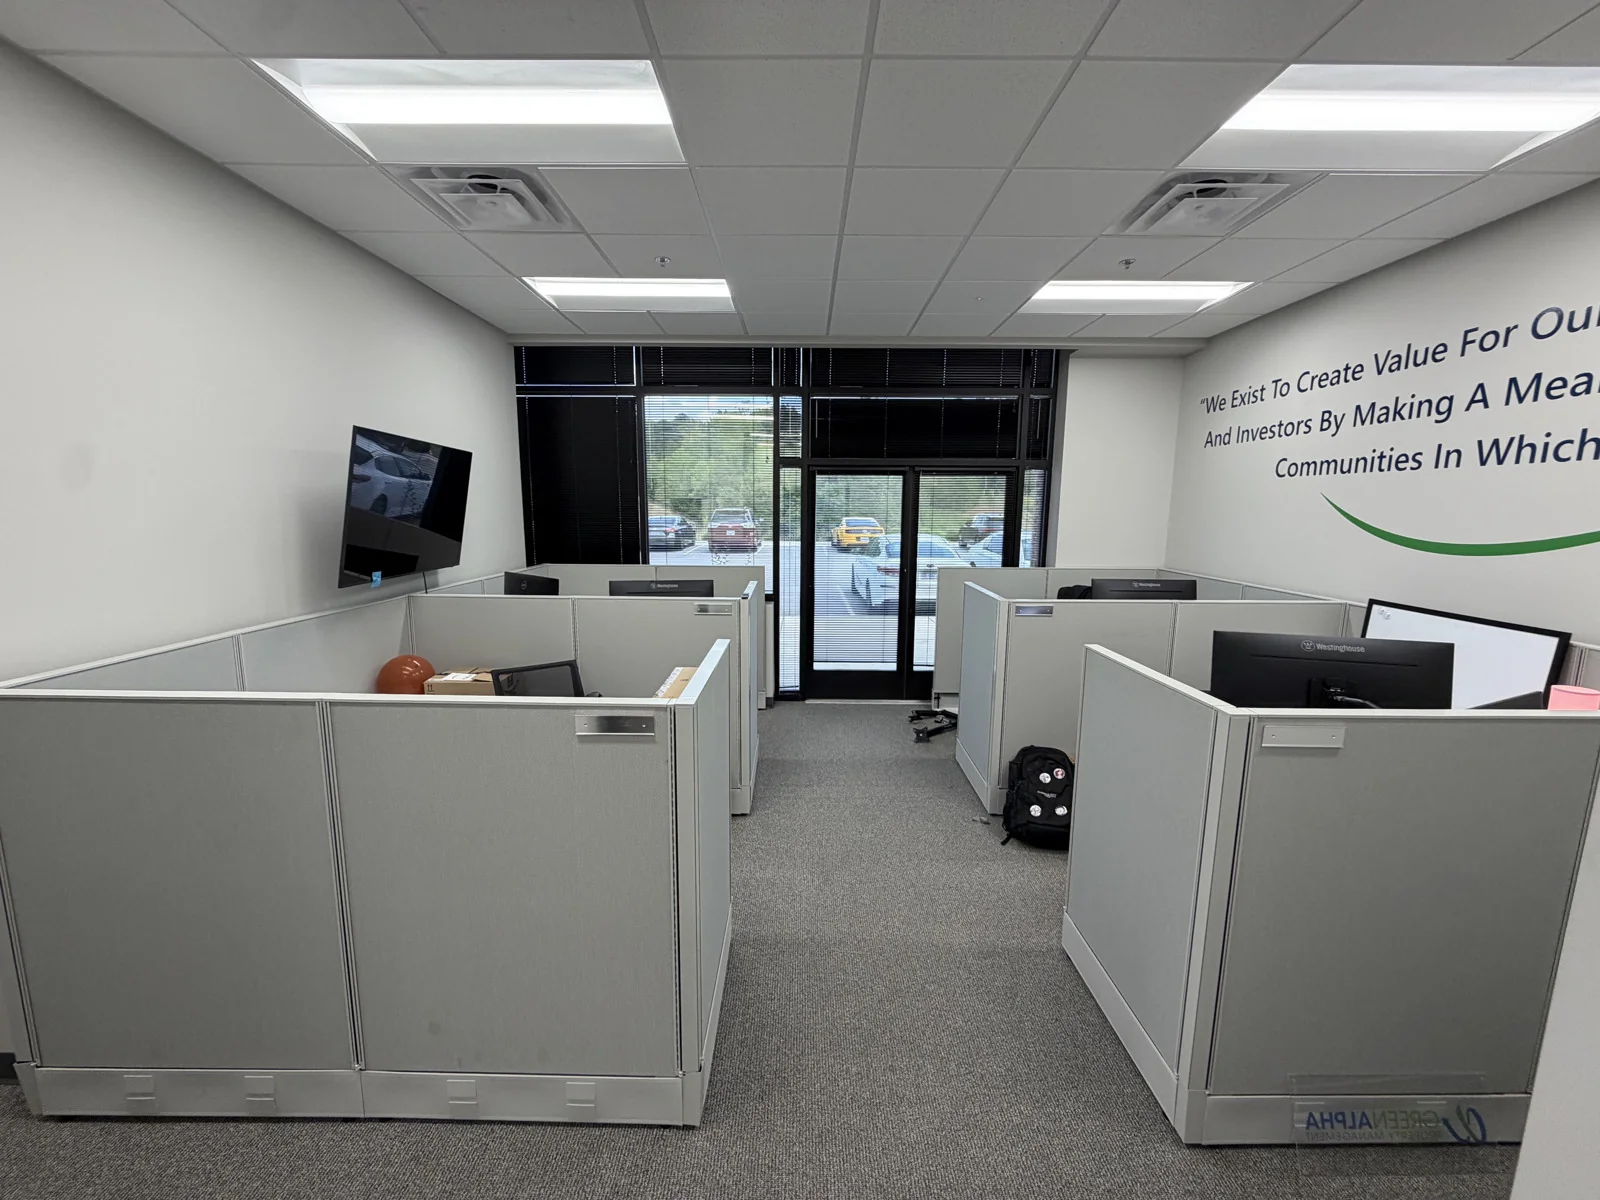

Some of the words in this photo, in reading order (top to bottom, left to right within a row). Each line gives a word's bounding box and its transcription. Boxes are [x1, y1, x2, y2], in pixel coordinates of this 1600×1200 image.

[1231, 385, 1266, 409] Exist
[1271, 378, 1290, 400] To
[1297, 362, 1364, 394] Create
[1373, 342, 1448, 376] Value
[1460, 324, 1518, 358] For
[1204, 426, 1232, 449] And
[1235, 416, 1313, 444] Investors
[1319, 409, 1346, 438] By
[1353, 393, 1454, 428] Making
[1464, 382, 1490, 413] A
[1503, 371, 1600, 407] Mea
[1275, 448, 1424, 479] Communities
[1434, 443, 1462, 470] In
[1477, 427, 1600, 468] Which
[1316, 642, 1366, 653] Westinghouse
